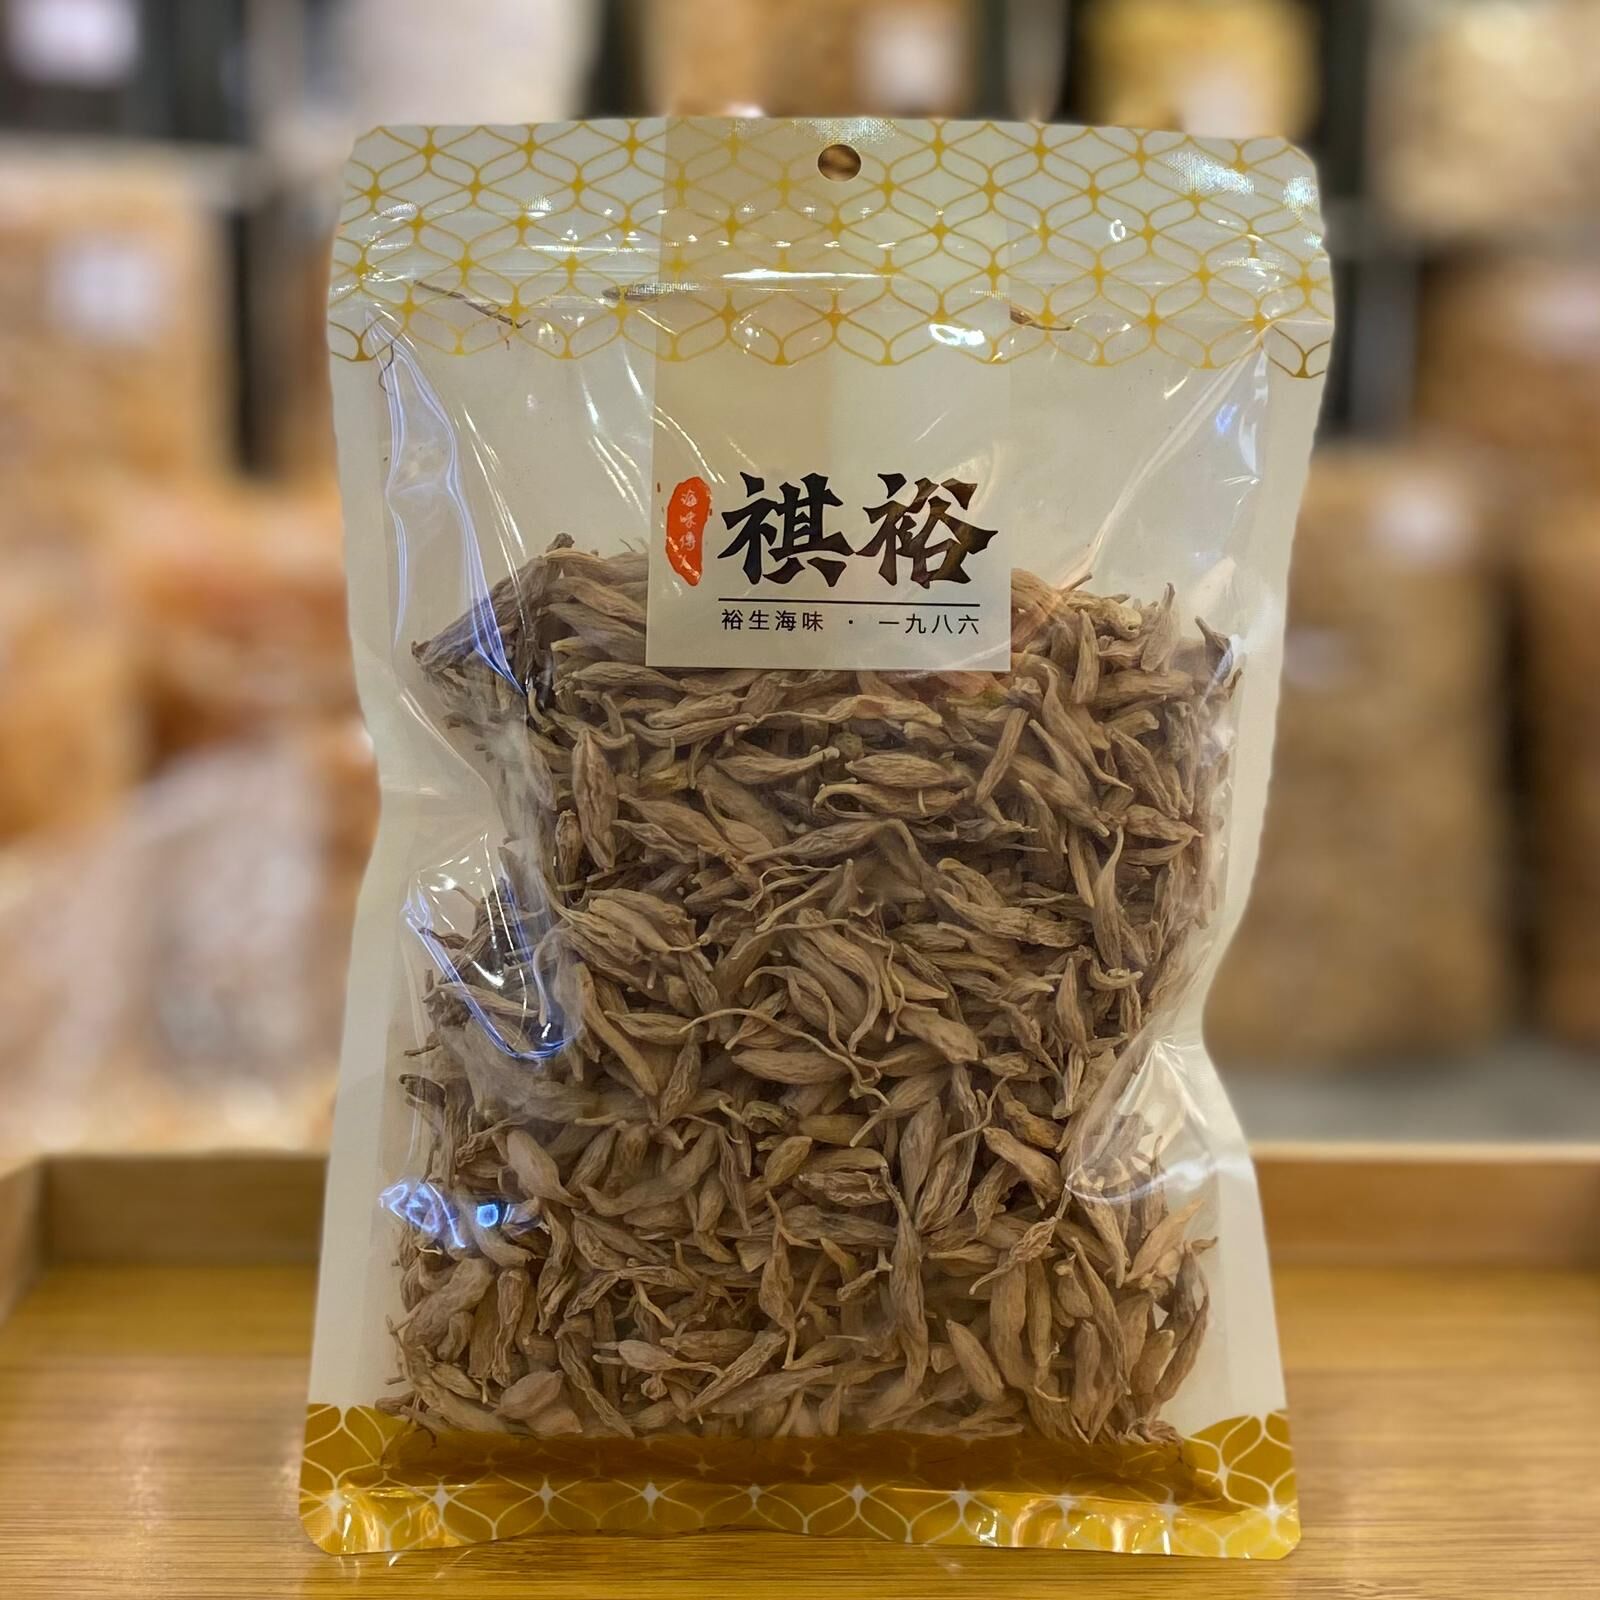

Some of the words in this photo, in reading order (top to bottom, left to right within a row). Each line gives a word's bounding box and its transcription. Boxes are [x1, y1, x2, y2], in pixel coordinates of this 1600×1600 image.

[716, 472, 998, 588] 祺裕
[721, 608, 824, 632] 裕生海味
[878, 613, 980, 636] 一九八六
